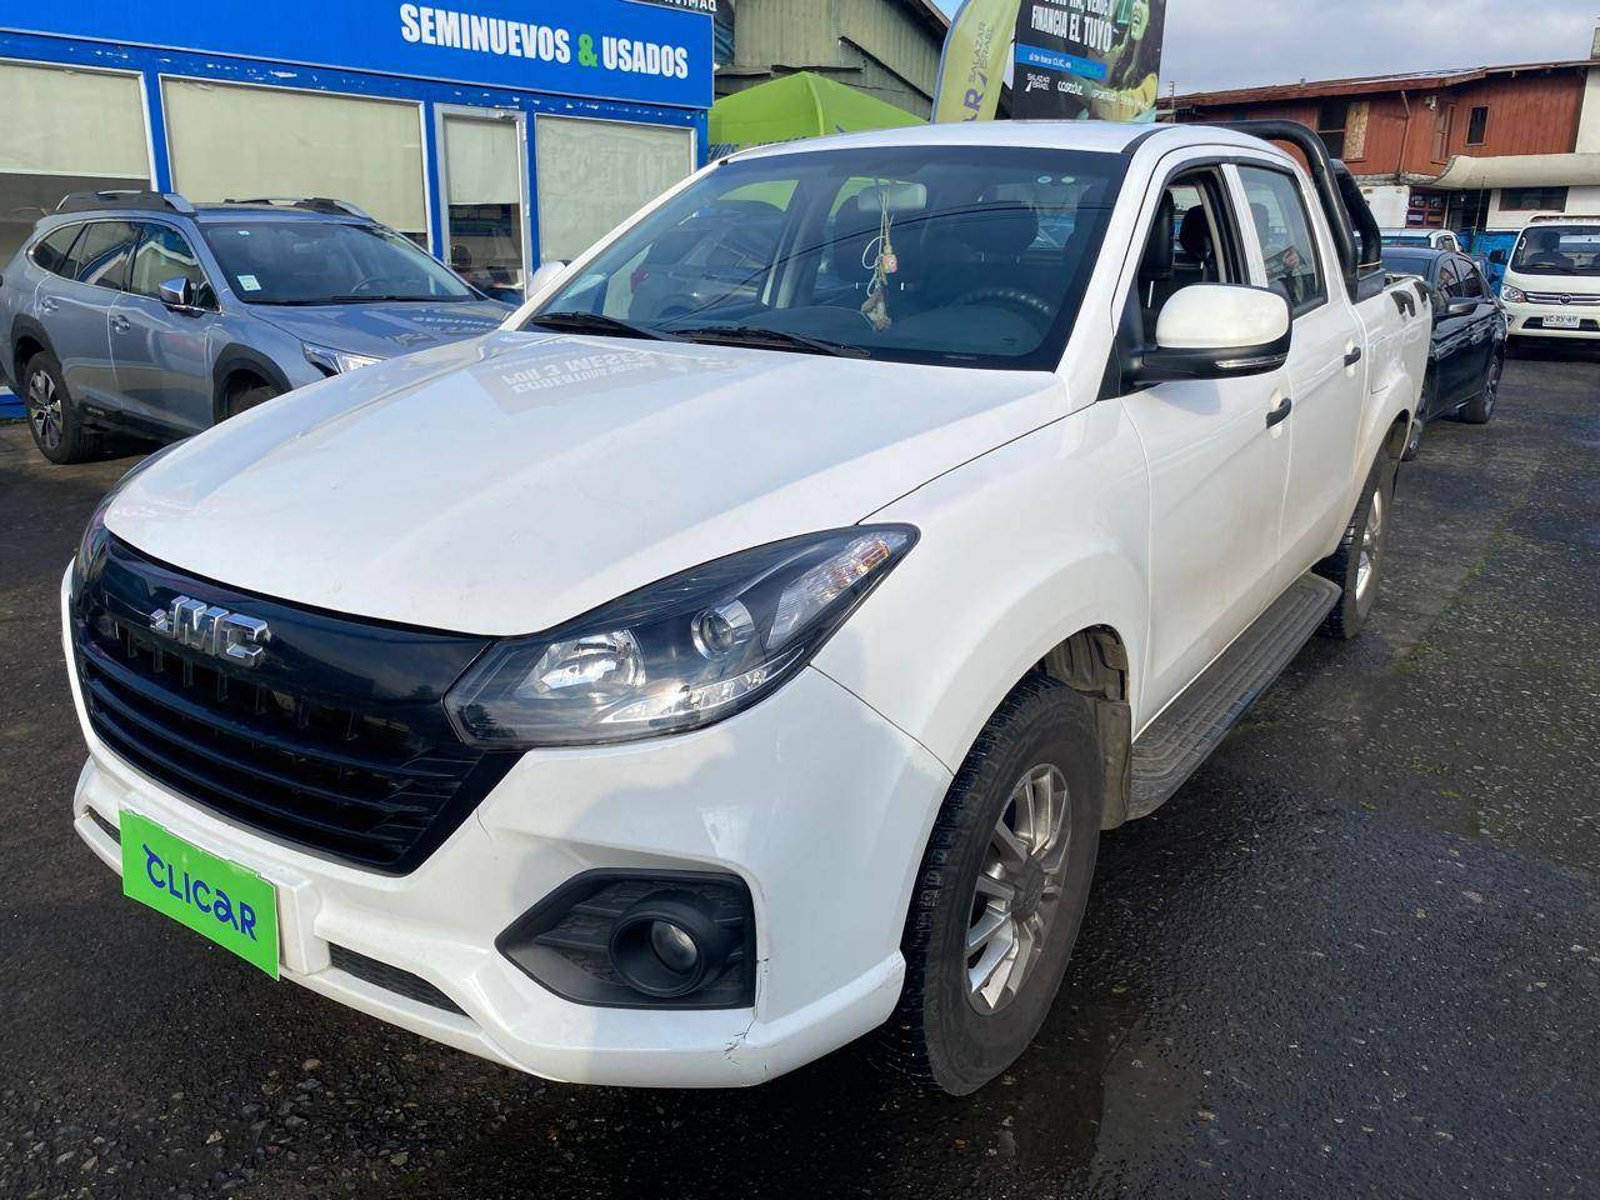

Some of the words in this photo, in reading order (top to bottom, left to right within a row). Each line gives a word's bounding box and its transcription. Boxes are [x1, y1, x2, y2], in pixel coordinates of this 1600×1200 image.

[400, 4, 570, 63] SEMINUEVOS
[578, 34, 597, 67] &
[602, 36, 689, 79] USADOS
[1031, 5, 1067, 38] FINANCIA
[1069, 13, 1080, 43] EL
[1084, 16, 1112, 52] TUYO
